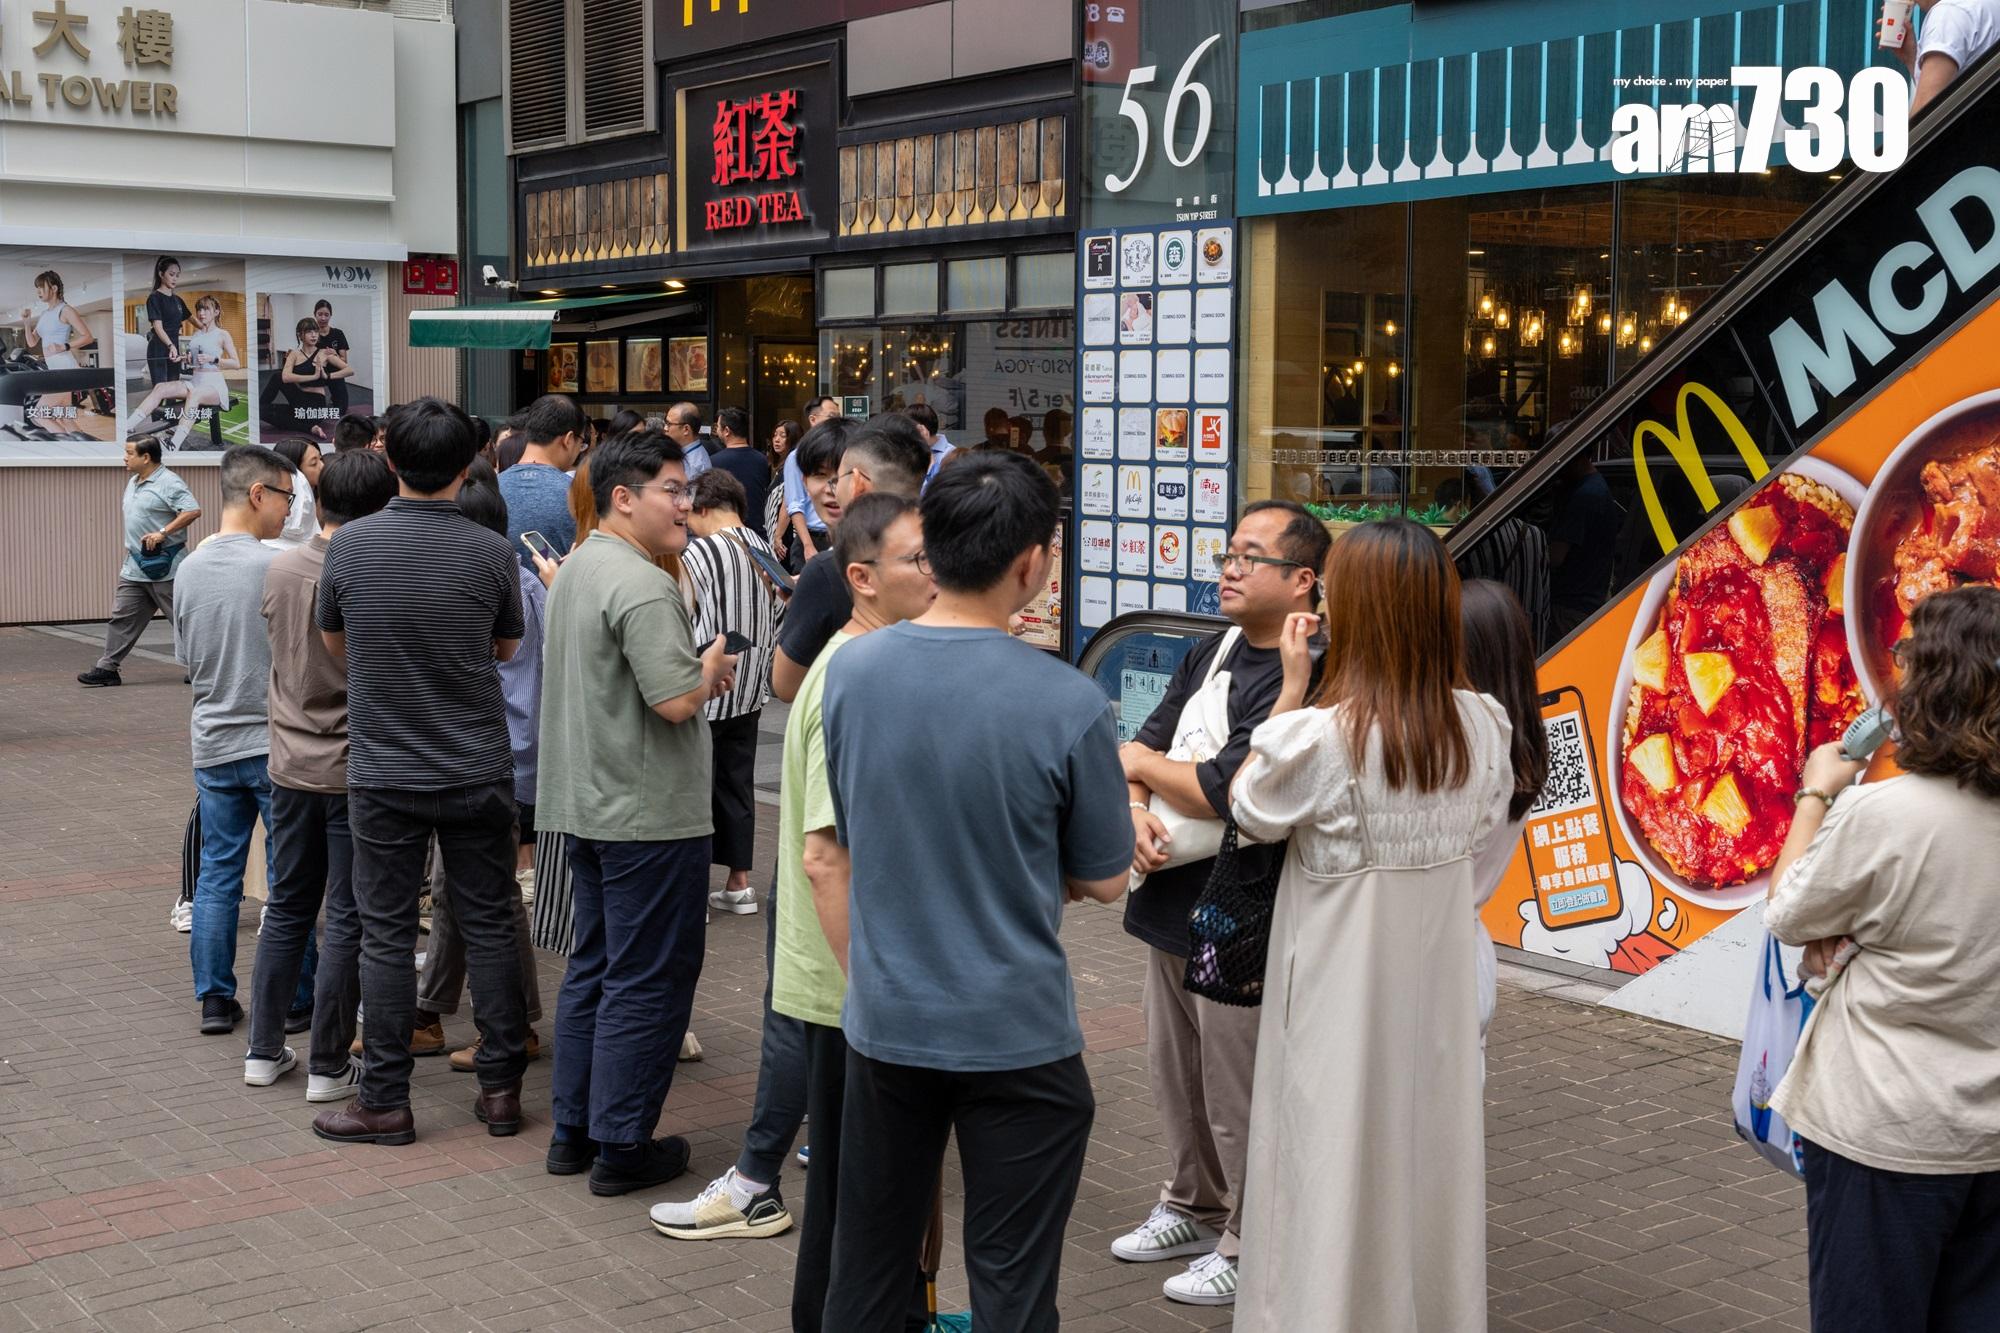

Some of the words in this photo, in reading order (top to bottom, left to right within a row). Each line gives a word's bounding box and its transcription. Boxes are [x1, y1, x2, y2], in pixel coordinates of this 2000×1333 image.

[32, 0, 174, 67] 大樓
[38, 72, 178, 120] TOWER
[1105, 33, 1221, 192] 56
[712, 88, 799, 187] 紅茶
[705, 195, 752, 231] RED
[758, 190, 804, 224] TEA
[1200, 210, 1217, 220] STREET
[325, 265, 371, 282] WOW
[26, 407, 77, 420] 女性專屬
[164, 407, 213, 421] 私人教練
[294, 407, 341, 420] 瑜伽課程
[1532, 813, 1600, 847] 網上點餐
[1553, 842, 1588, 869] 服務
